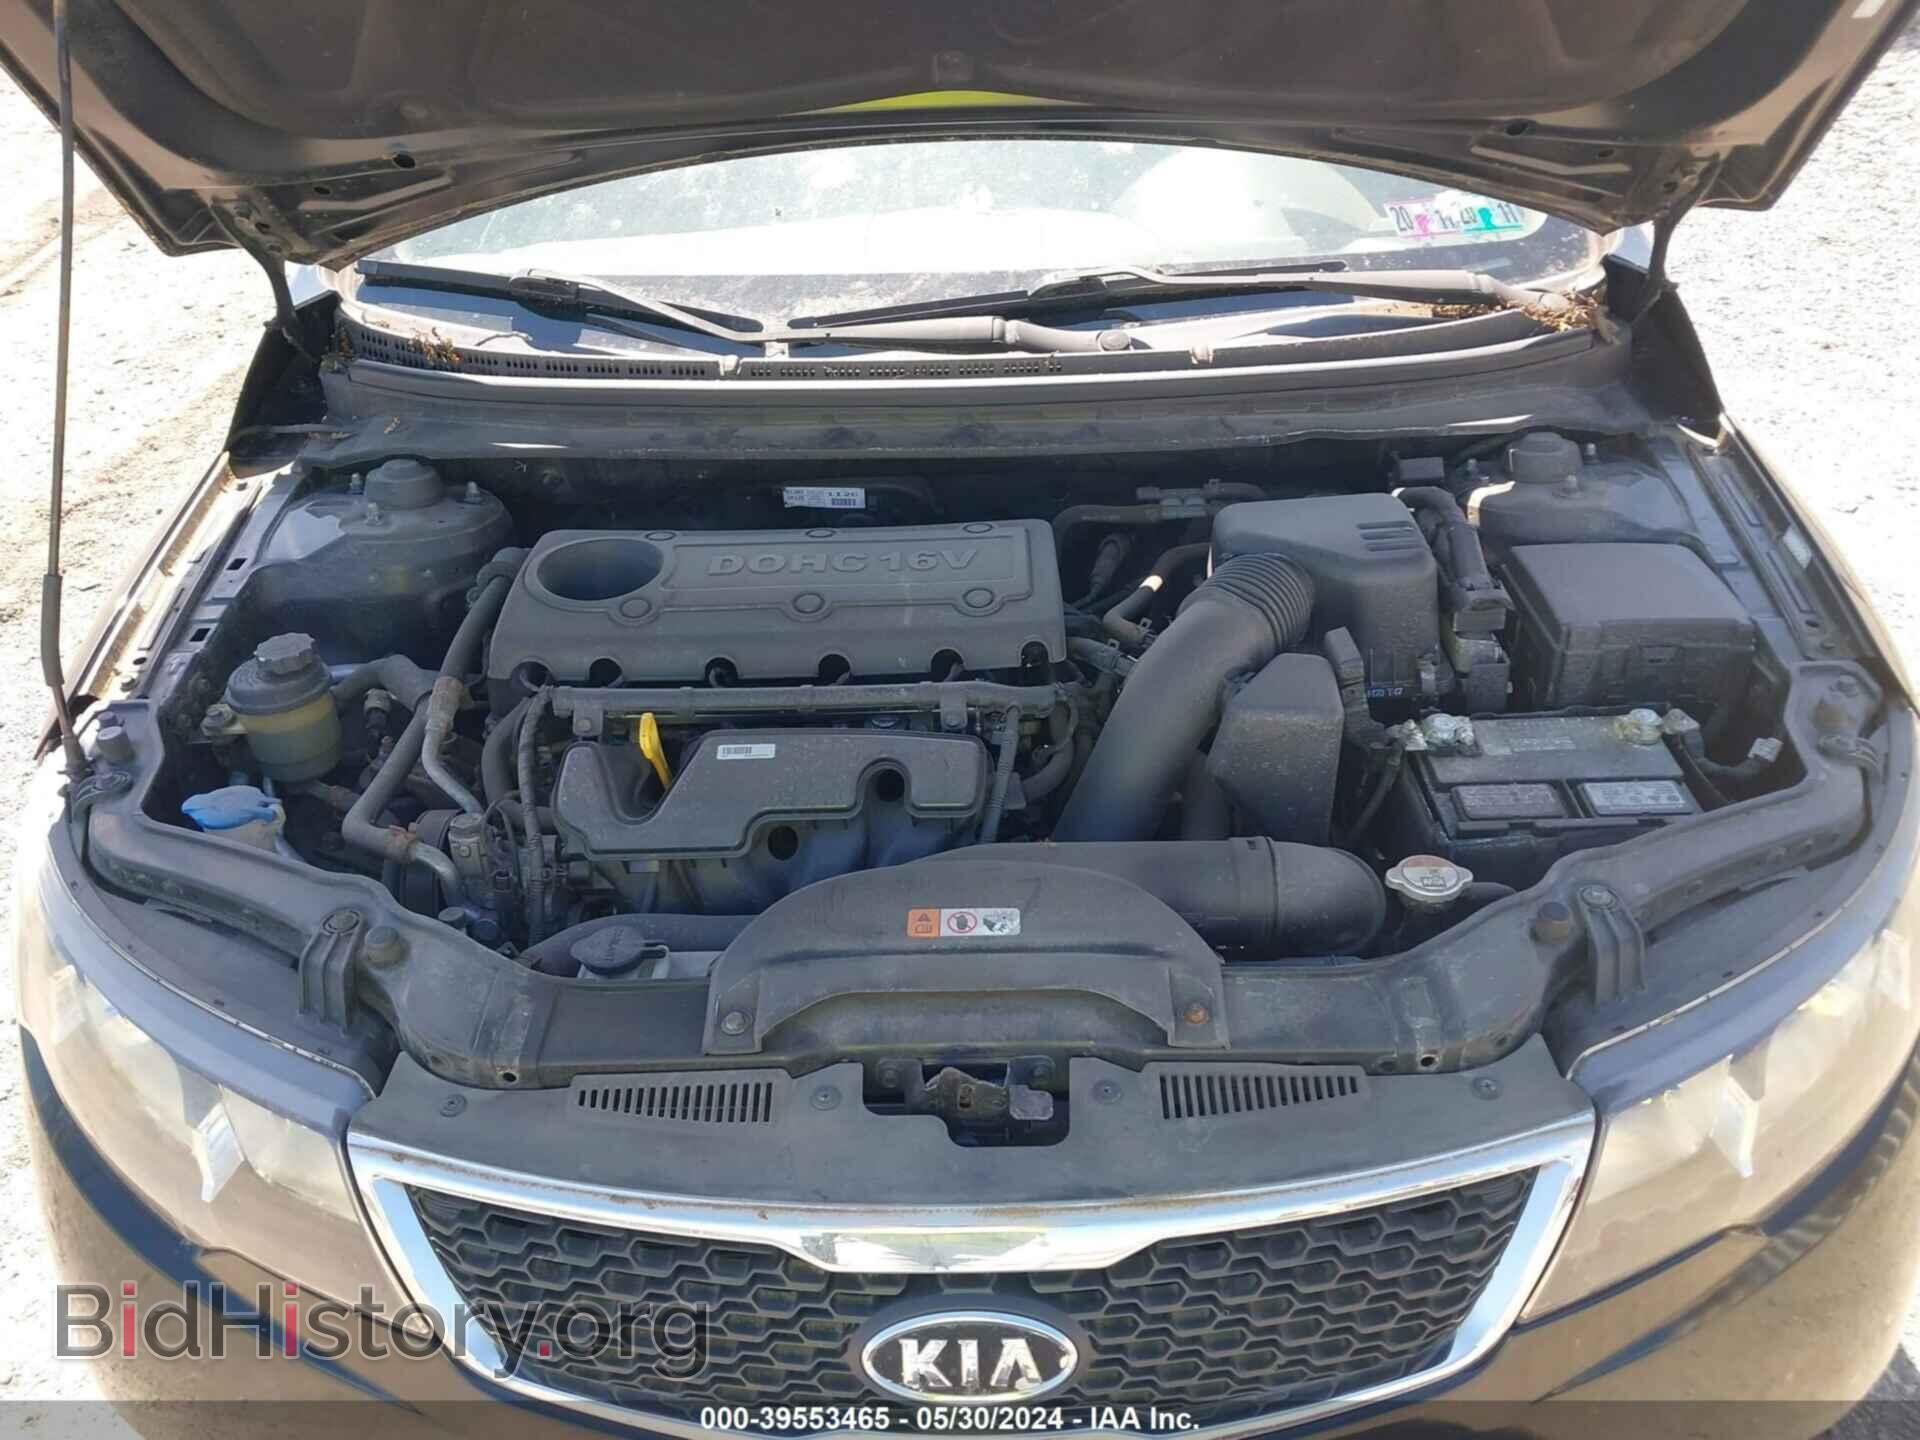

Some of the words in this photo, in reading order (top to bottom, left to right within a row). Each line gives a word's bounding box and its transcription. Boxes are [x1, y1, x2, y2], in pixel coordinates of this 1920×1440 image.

[1389, 205, 1414, 232] 20
[707, 551, 869, 576] DOHC
[879, 550, 977, 573] 16V
[898, 1338, 1043, 1391] KIA
